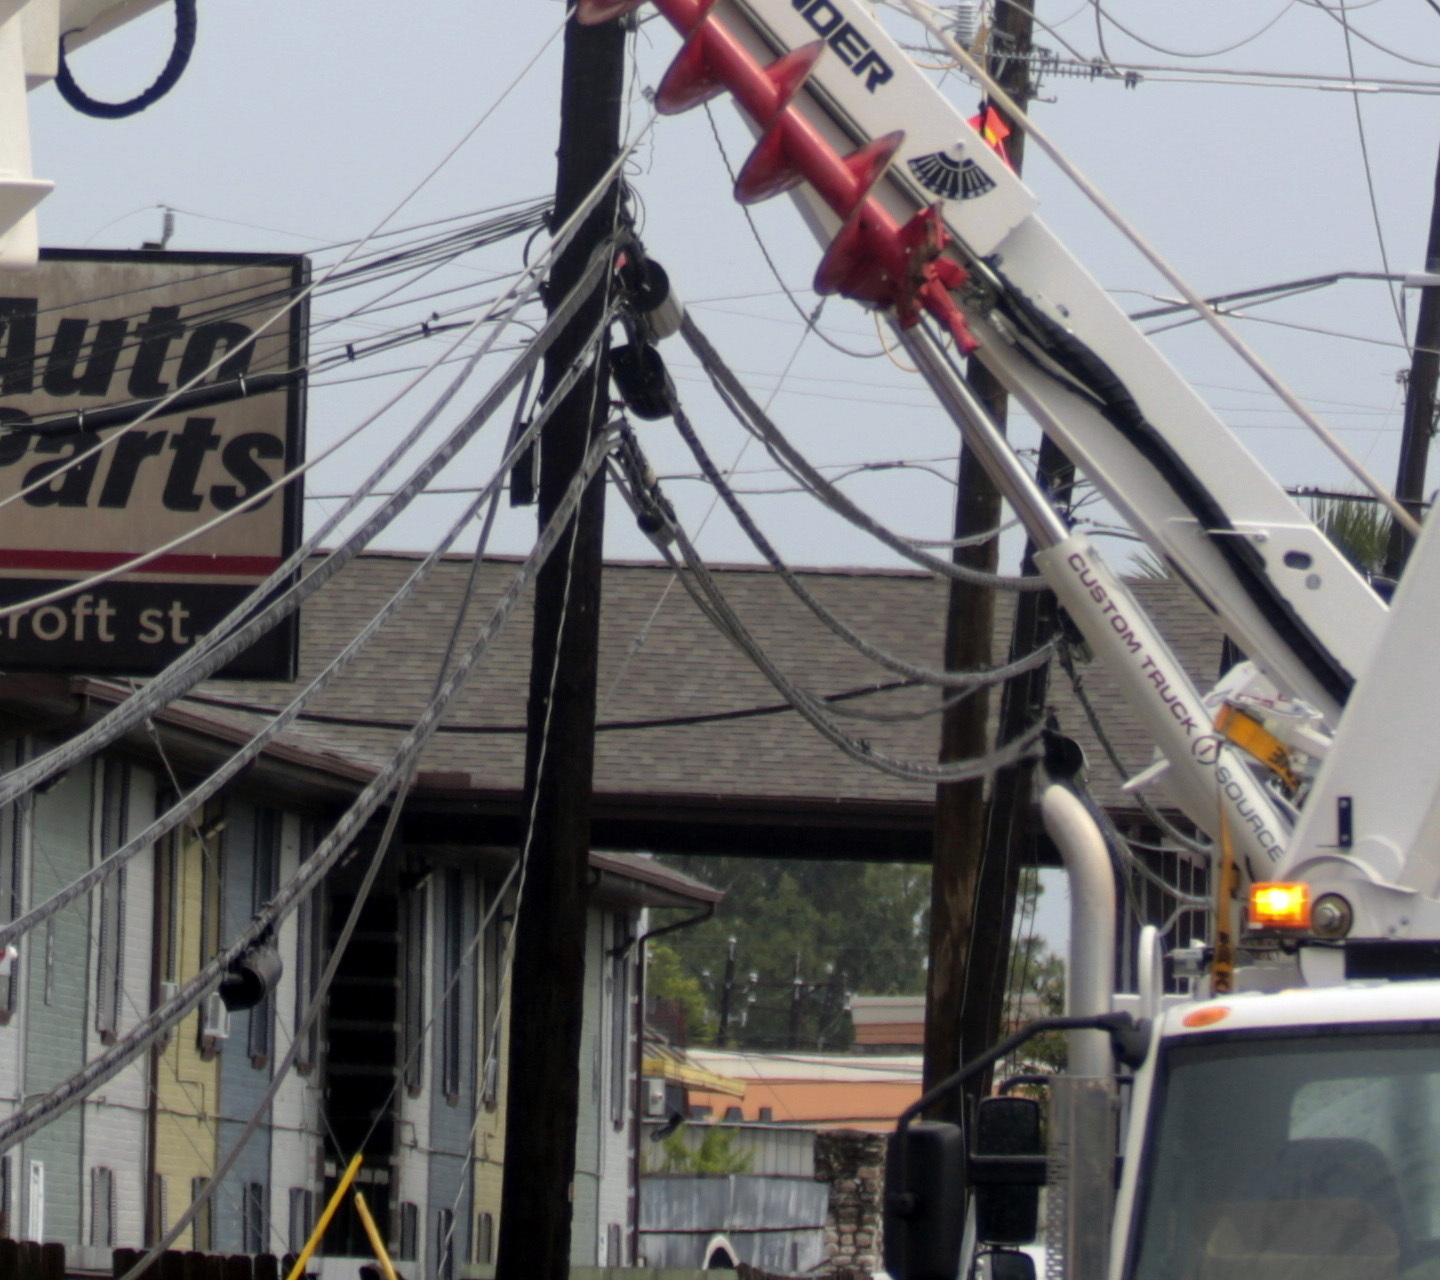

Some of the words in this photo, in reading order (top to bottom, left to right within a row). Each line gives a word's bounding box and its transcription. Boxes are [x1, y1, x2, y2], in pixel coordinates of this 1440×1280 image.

[1068, 552, 1142, 654] CUSTOM
[1140, 654, 1198, 736] TRUCK
[1215, 765, 1285, 863] SOURCE
